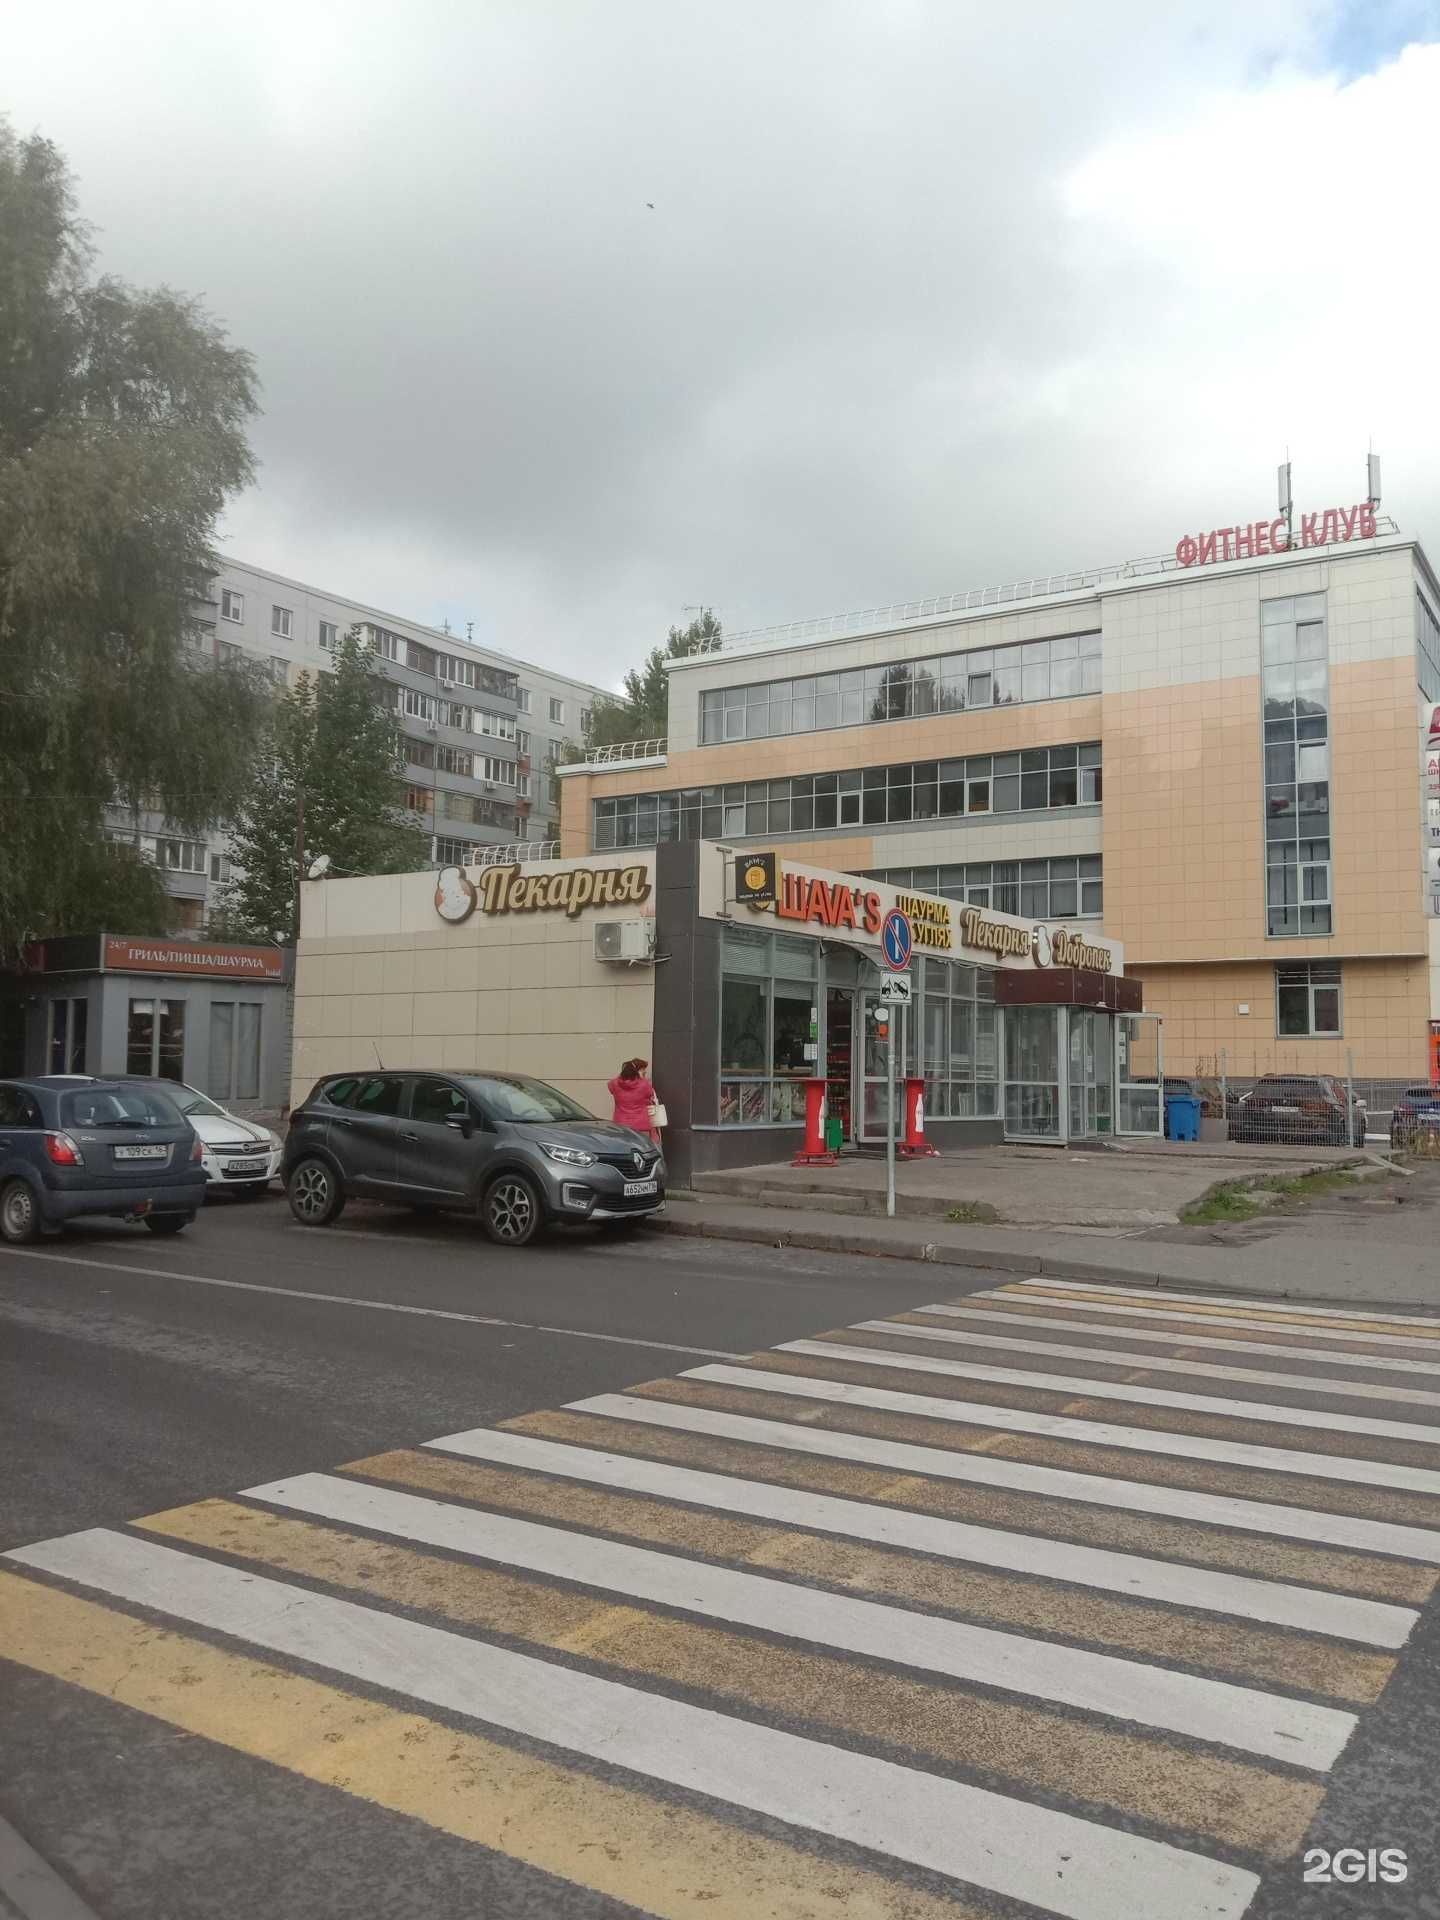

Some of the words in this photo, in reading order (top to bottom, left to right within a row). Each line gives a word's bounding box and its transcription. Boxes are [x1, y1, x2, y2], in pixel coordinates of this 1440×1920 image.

[1176, 517, 1288, 567] ФИТНЕС
[1301, 503, 1376, 549] КЛУБ
[480, 863, 652, 917] Пекарня
[960, 907, 1031, 961] Пекарня
[1052, 930, 1112, 972] Добропек
